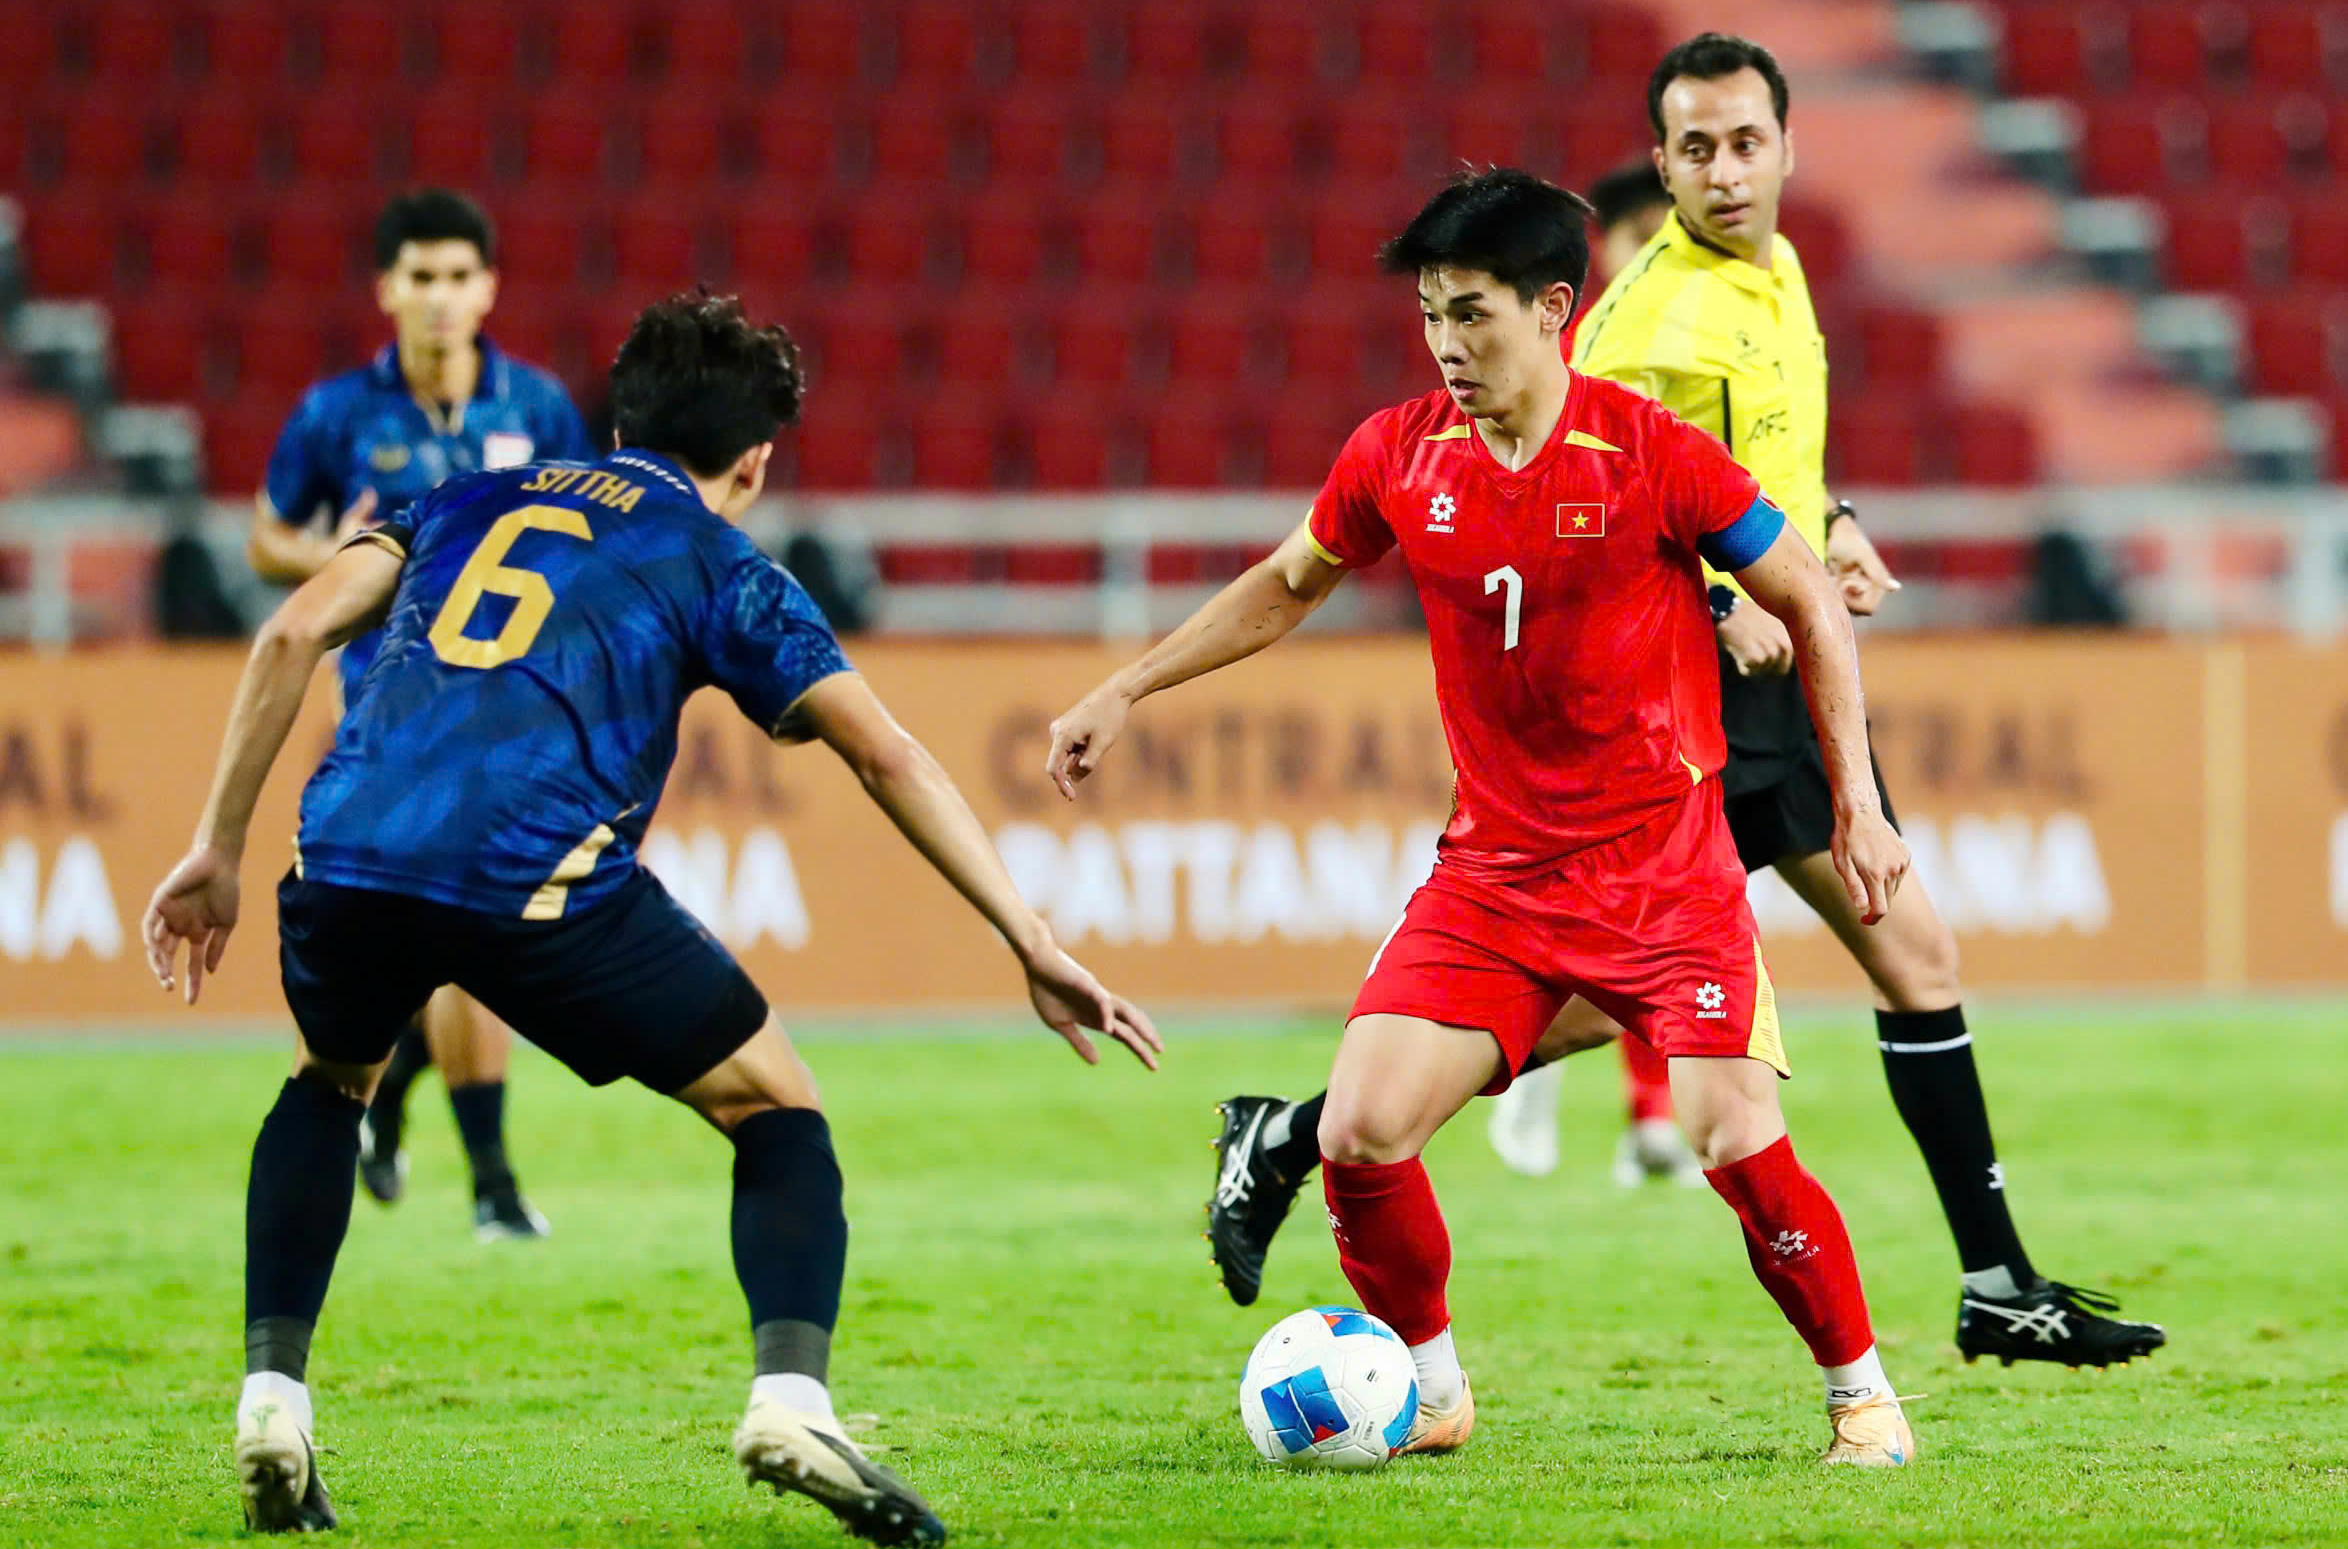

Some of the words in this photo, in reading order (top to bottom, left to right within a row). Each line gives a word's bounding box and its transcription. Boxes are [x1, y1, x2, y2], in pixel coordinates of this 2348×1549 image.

[520, 468, 647, 514] SITTHA
[428, 504, 593, 669] 6
[1484, 564, 1523, 652] 7
[988, 702, 1458, 814] CNTRAL
